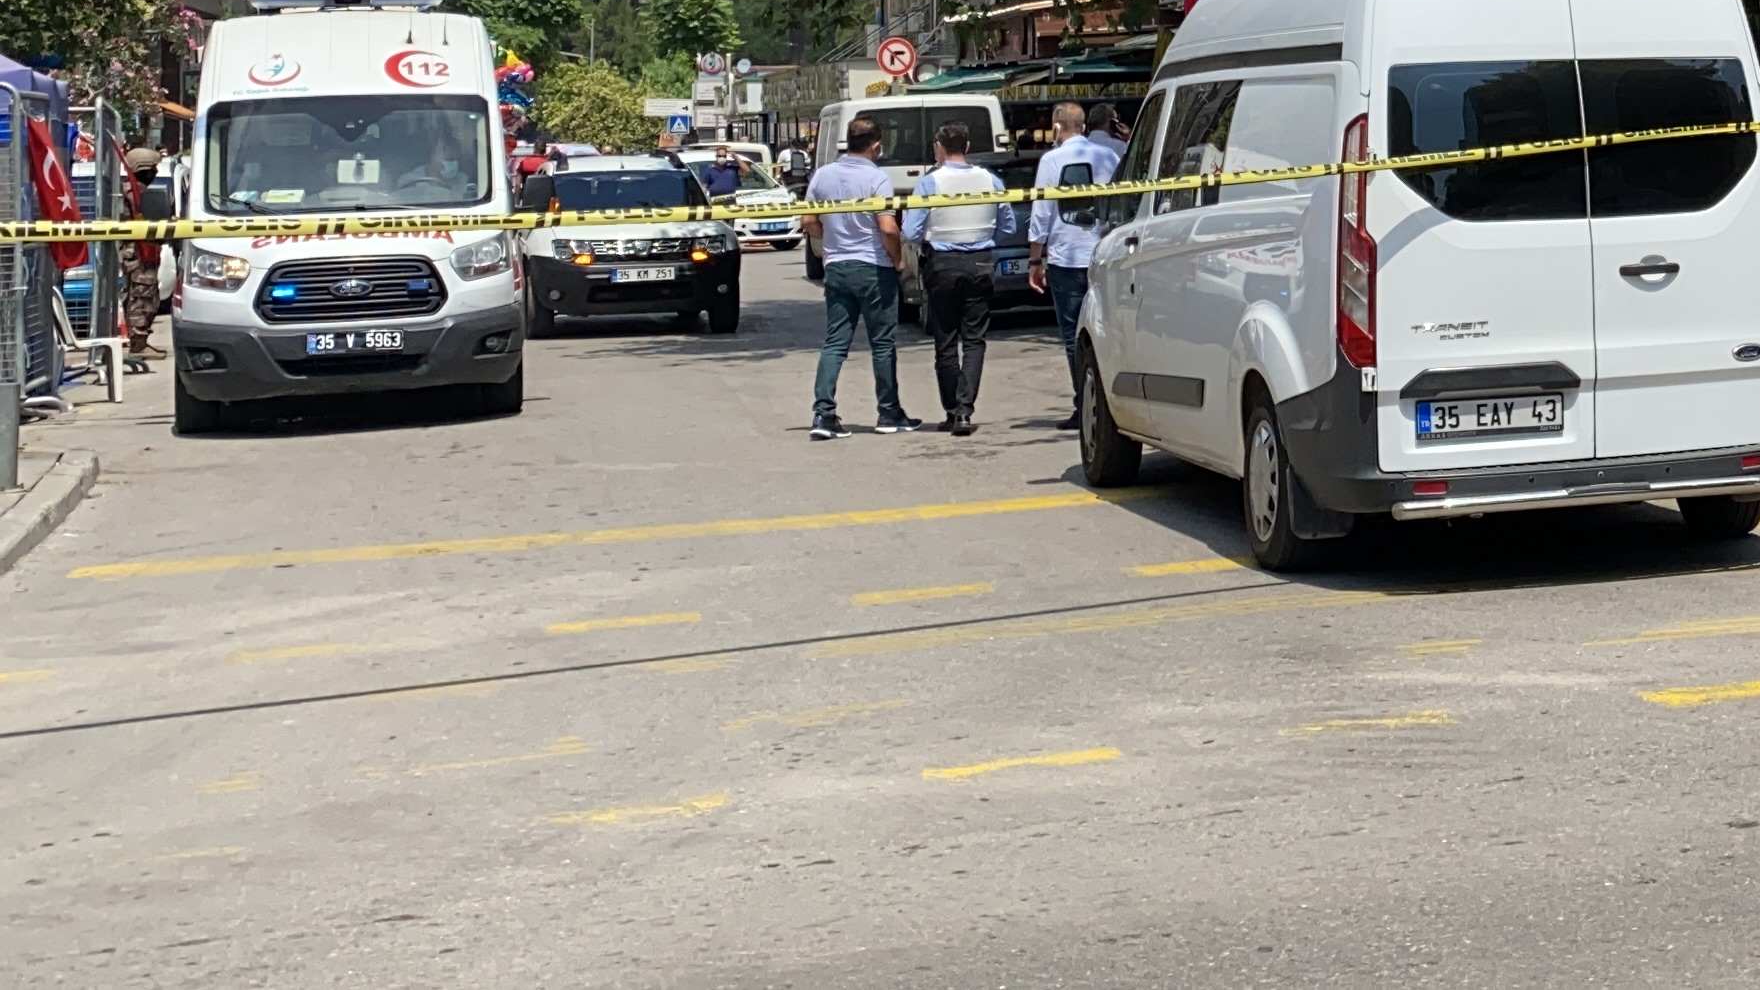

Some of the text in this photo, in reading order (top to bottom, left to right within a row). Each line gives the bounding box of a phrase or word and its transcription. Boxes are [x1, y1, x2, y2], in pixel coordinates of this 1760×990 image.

[401, 61, 450, 76] 112
[617, 267, 673, 280] 35 KM 251
[316, 332, 401, 350] 35 V 5963
[1434, 405, 1460, 429] 35
[1476, 401, 1515, 427] EAY
[1532, 399, 1557, 423] 43
